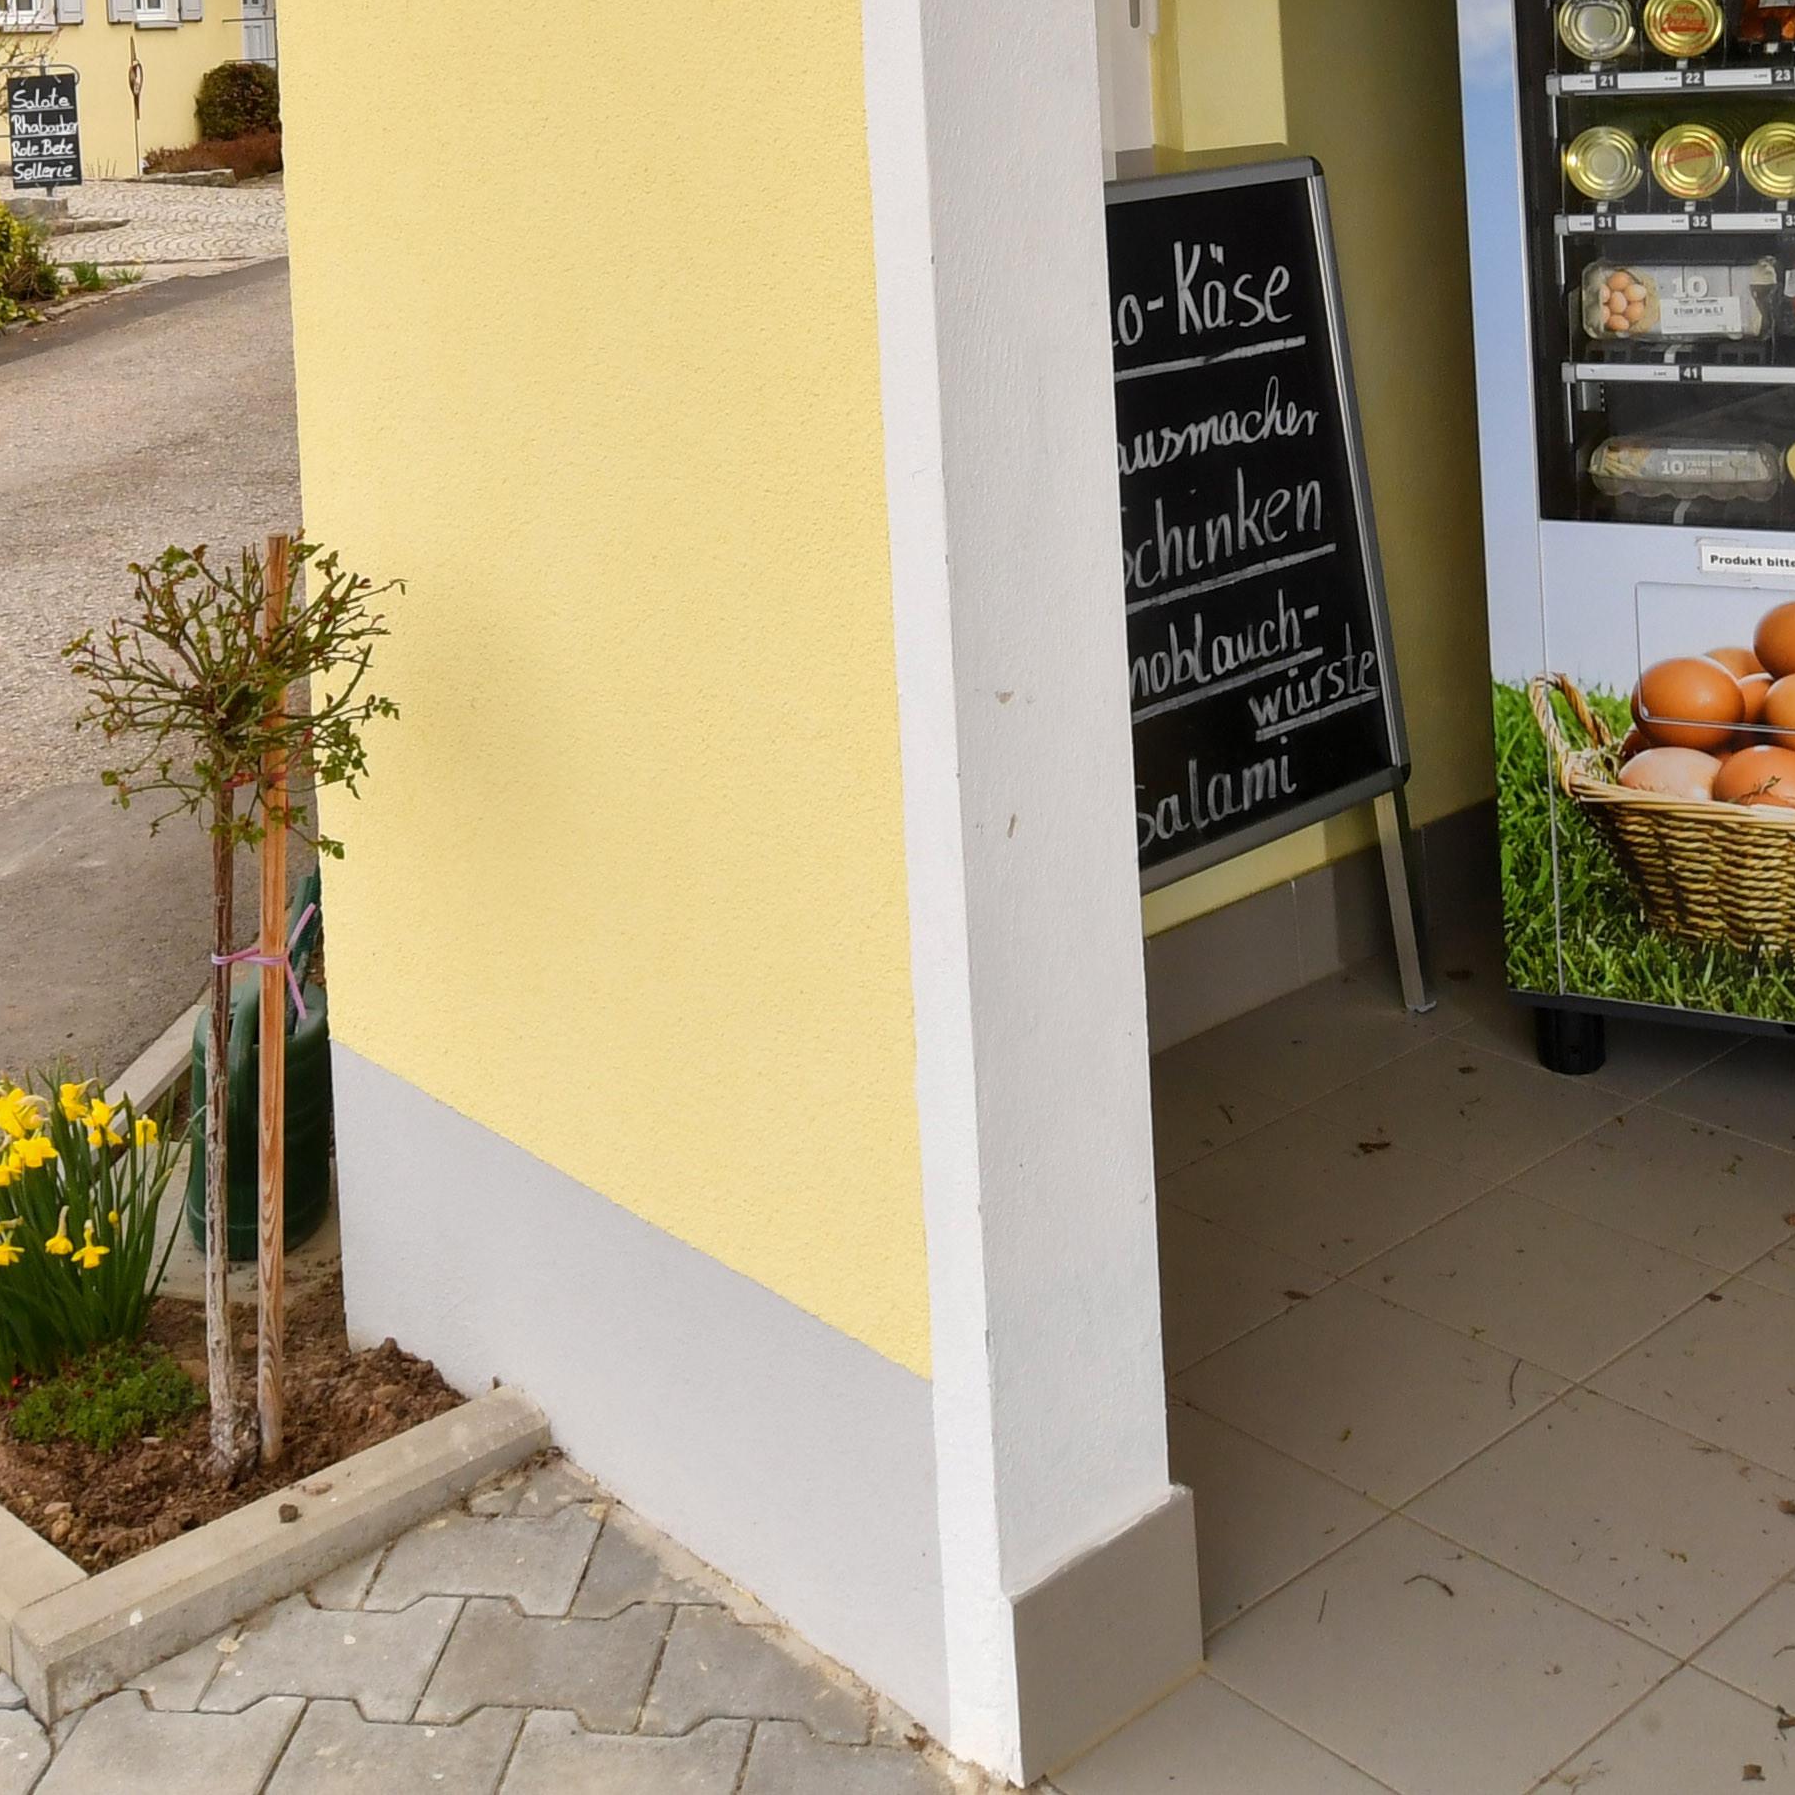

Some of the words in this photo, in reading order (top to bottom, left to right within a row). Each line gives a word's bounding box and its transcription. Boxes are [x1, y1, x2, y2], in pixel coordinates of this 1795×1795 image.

[1600, 76, 1614, 87] 21
[1685, 73, 1701, 84] 22
[1775, 69, 1791, 81] 23
[12, 87, 71, 109] Salate
[11, 113, 78, 135] Rhabarber
[12, 140, 39, 157] Rote
[41, 138, 74, 156] Bete
[14, 161, 74, 181] Sellerie
[1598, 216, 1612, 227] 31
[1692, 216, 1708, 228] 32
[1112, 240, 1293, 346] o-Käse
[1672, 275, 1709, 298] 10
[1683, 367, 1698, 379] 41
[1661, 460, 1685, 475] 10
[1710, 554, 1763, 567] Produkt
[1248, 622, 1381, 727] würste
